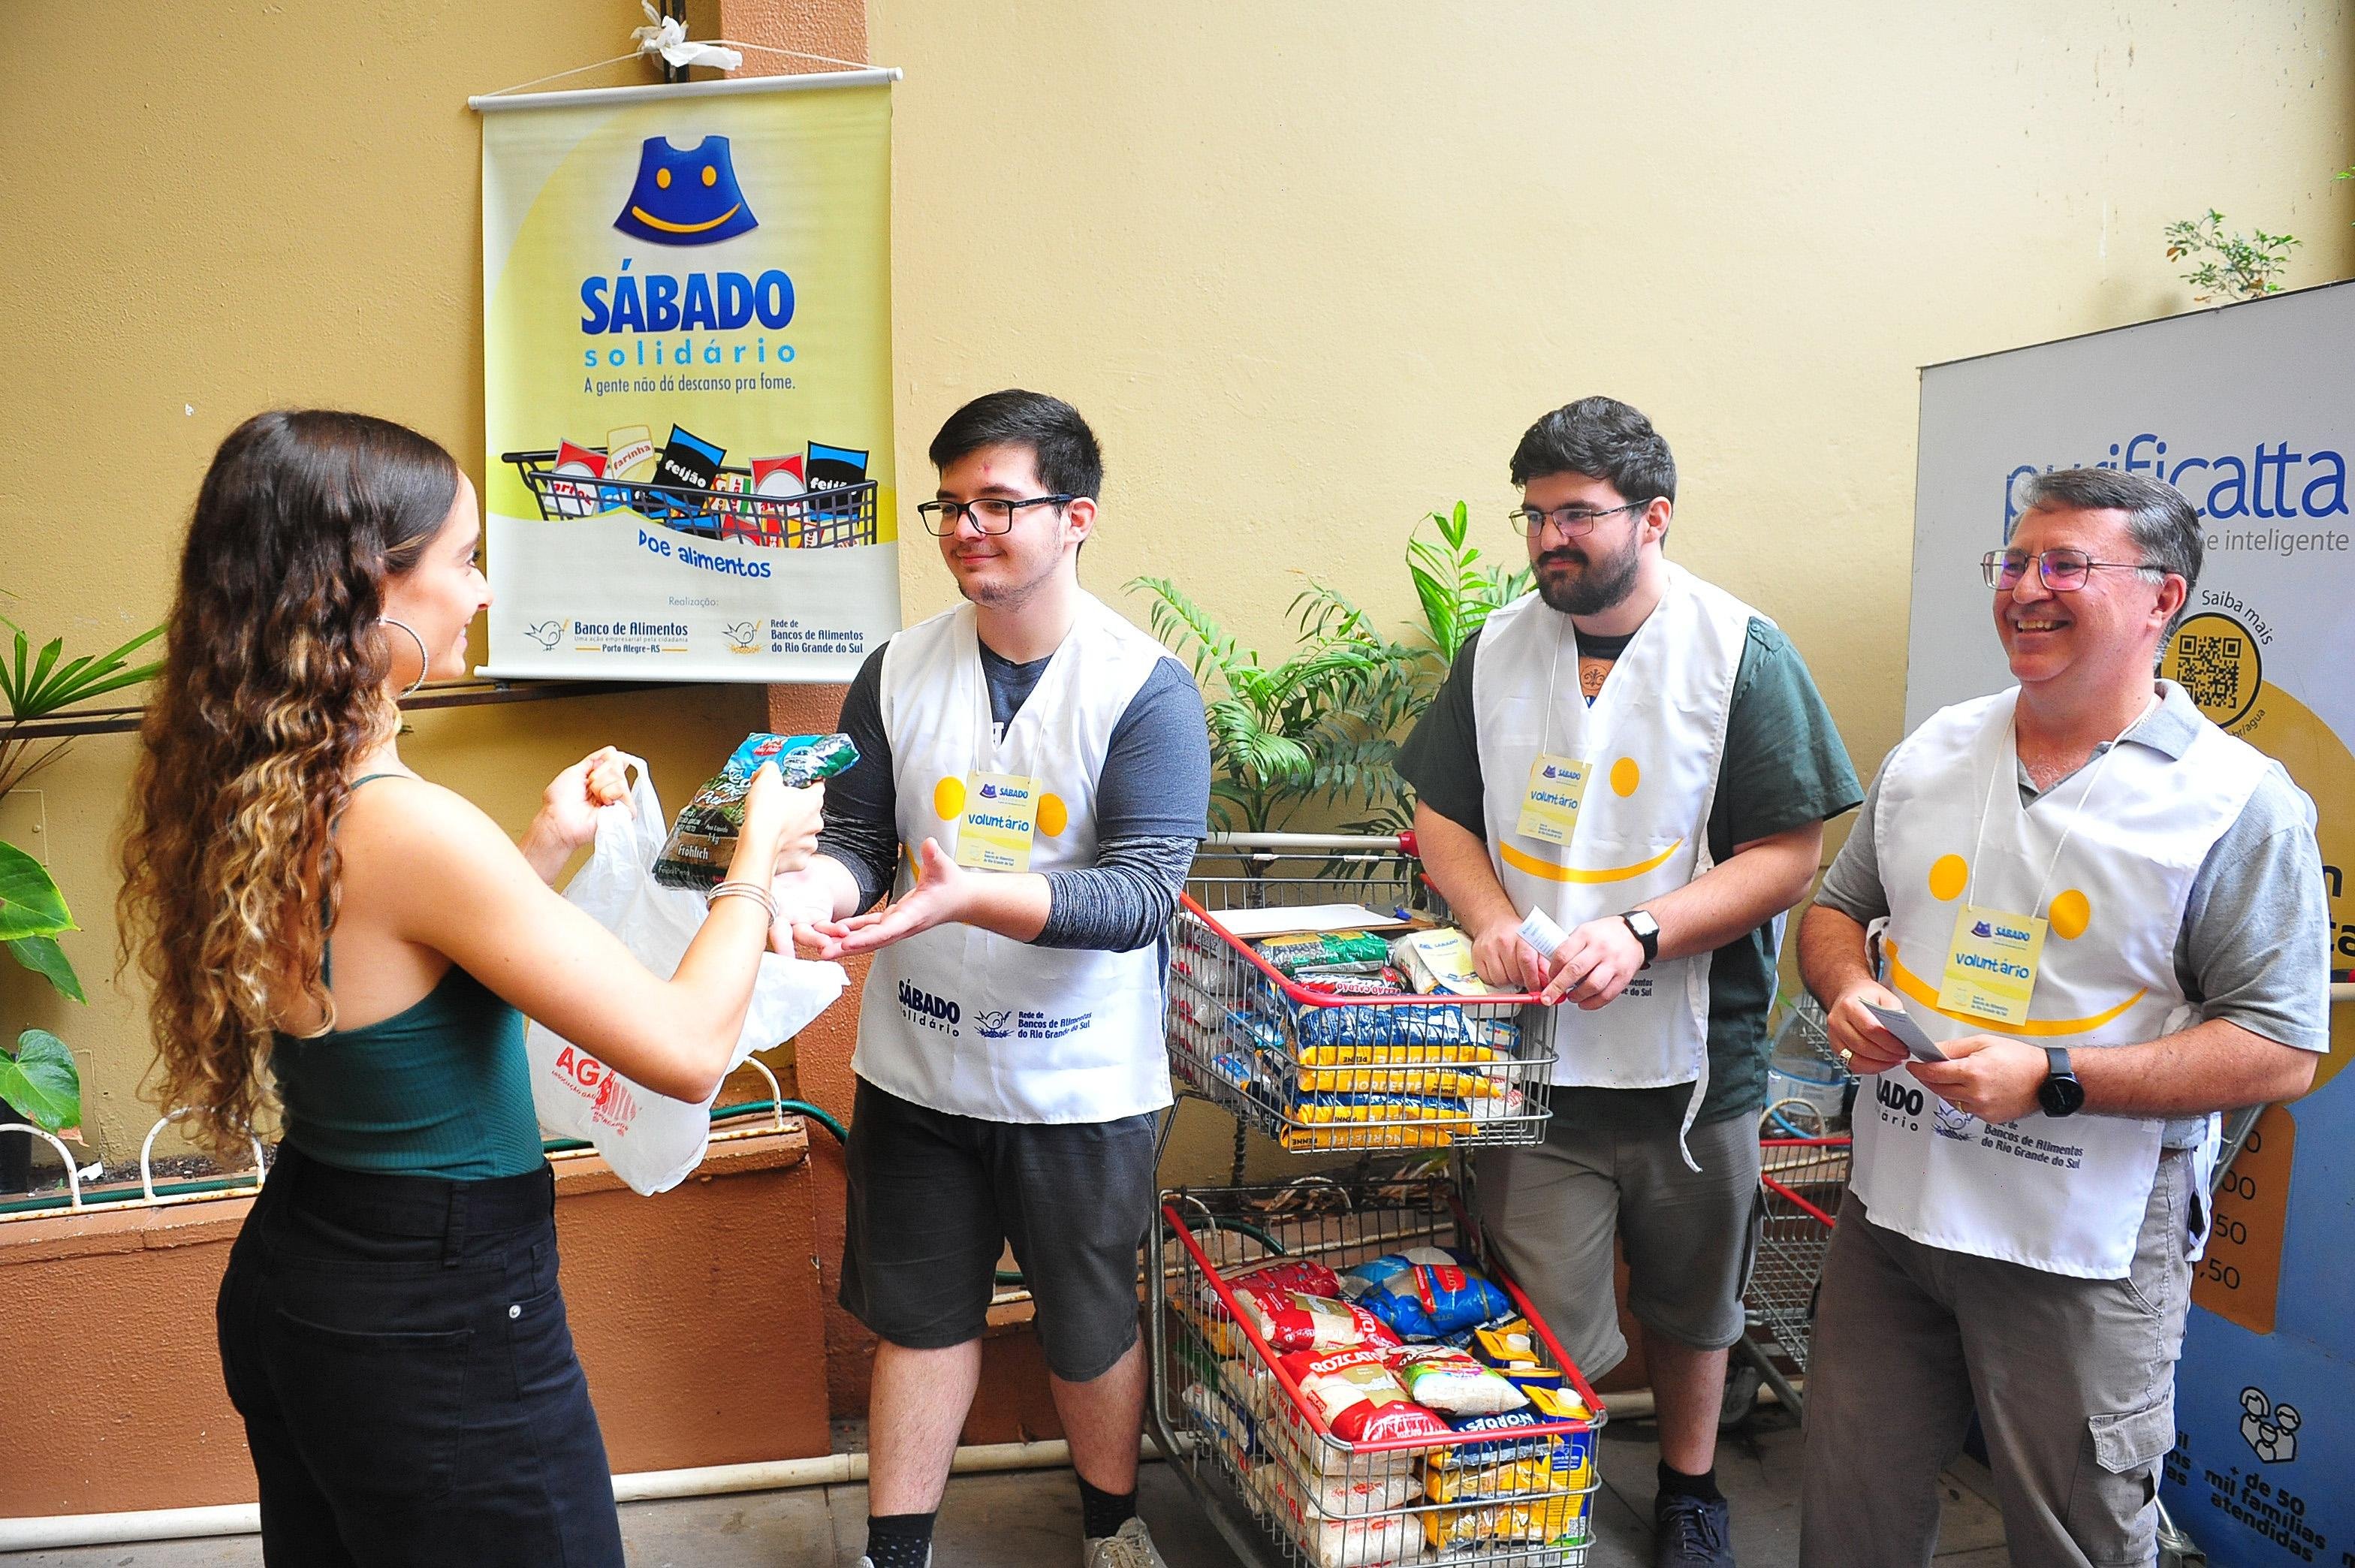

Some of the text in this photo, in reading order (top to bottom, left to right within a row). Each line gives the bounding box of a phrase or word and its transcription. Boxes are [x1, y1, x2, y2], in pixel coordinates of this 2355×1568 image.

[580, 258, 795, 336] SÁBADO
[583, 338, 797, 368] solidário
[584, 372, 796, 397] A gente não dá descanso pra fome.
[614, 442, 652, 470] farinha
[665, 460, 707, 488] feijão
[2004, 433, 2349, 547] pficatta
[638, 529, 771, 578] Doe alimentos
[2225, 529, 2349, 556] inteligente
[668, 596, 719, 608] Realização:
[574, 622, 688, 636] Banco de Alimentos
[770, 620, 798, 628] Rede de
[2202, 590, 2274, 645] Saiba mais
[771, 630, 864, 641] Bancos de Alimentos
[771, 643, 863, 653] do Rio Grande do Sul
[602, 644, 621, 653] Porto
[999, 786, 1029, 799] SÁBADO
[1530, 789, 1578, 810] voluntário
[968, 813, 1030, 832] voluntário
[677, 844, 709, 860] Fröhlich
[1995, 925, 2031, 942] SÁBADO
[1955, 953, 2030, 978] voluntário
[898, 978, 960, 1025] SÁBADO
[1630, 988, 1639, 997] do
[1641, 988, 1652, 997] Sul
[902, 1006, 960, 1037] olidário
[1018, 1012, 1092, 1028] Bancos de Alimentos
[1018, 1029, 1027, 1038] do
[1030, 1030, 1043, 1039] Rio
[1045, 1028, 1069, 1039] Grande
[1079, 1020, 1090, 1030] Sul
[1981, 1136, 2081, 1169] do Rio Grande do Sul
[1984, 1124, 2084, 1156] Bancos de Alimentos
[2205, 1470, 2236, 1497] mil
[2245, 1473, 2271, 1497] de
[2277, 1488, 2305, 1516] 50
[2211, 1492, 2314, 1562] atendidas
